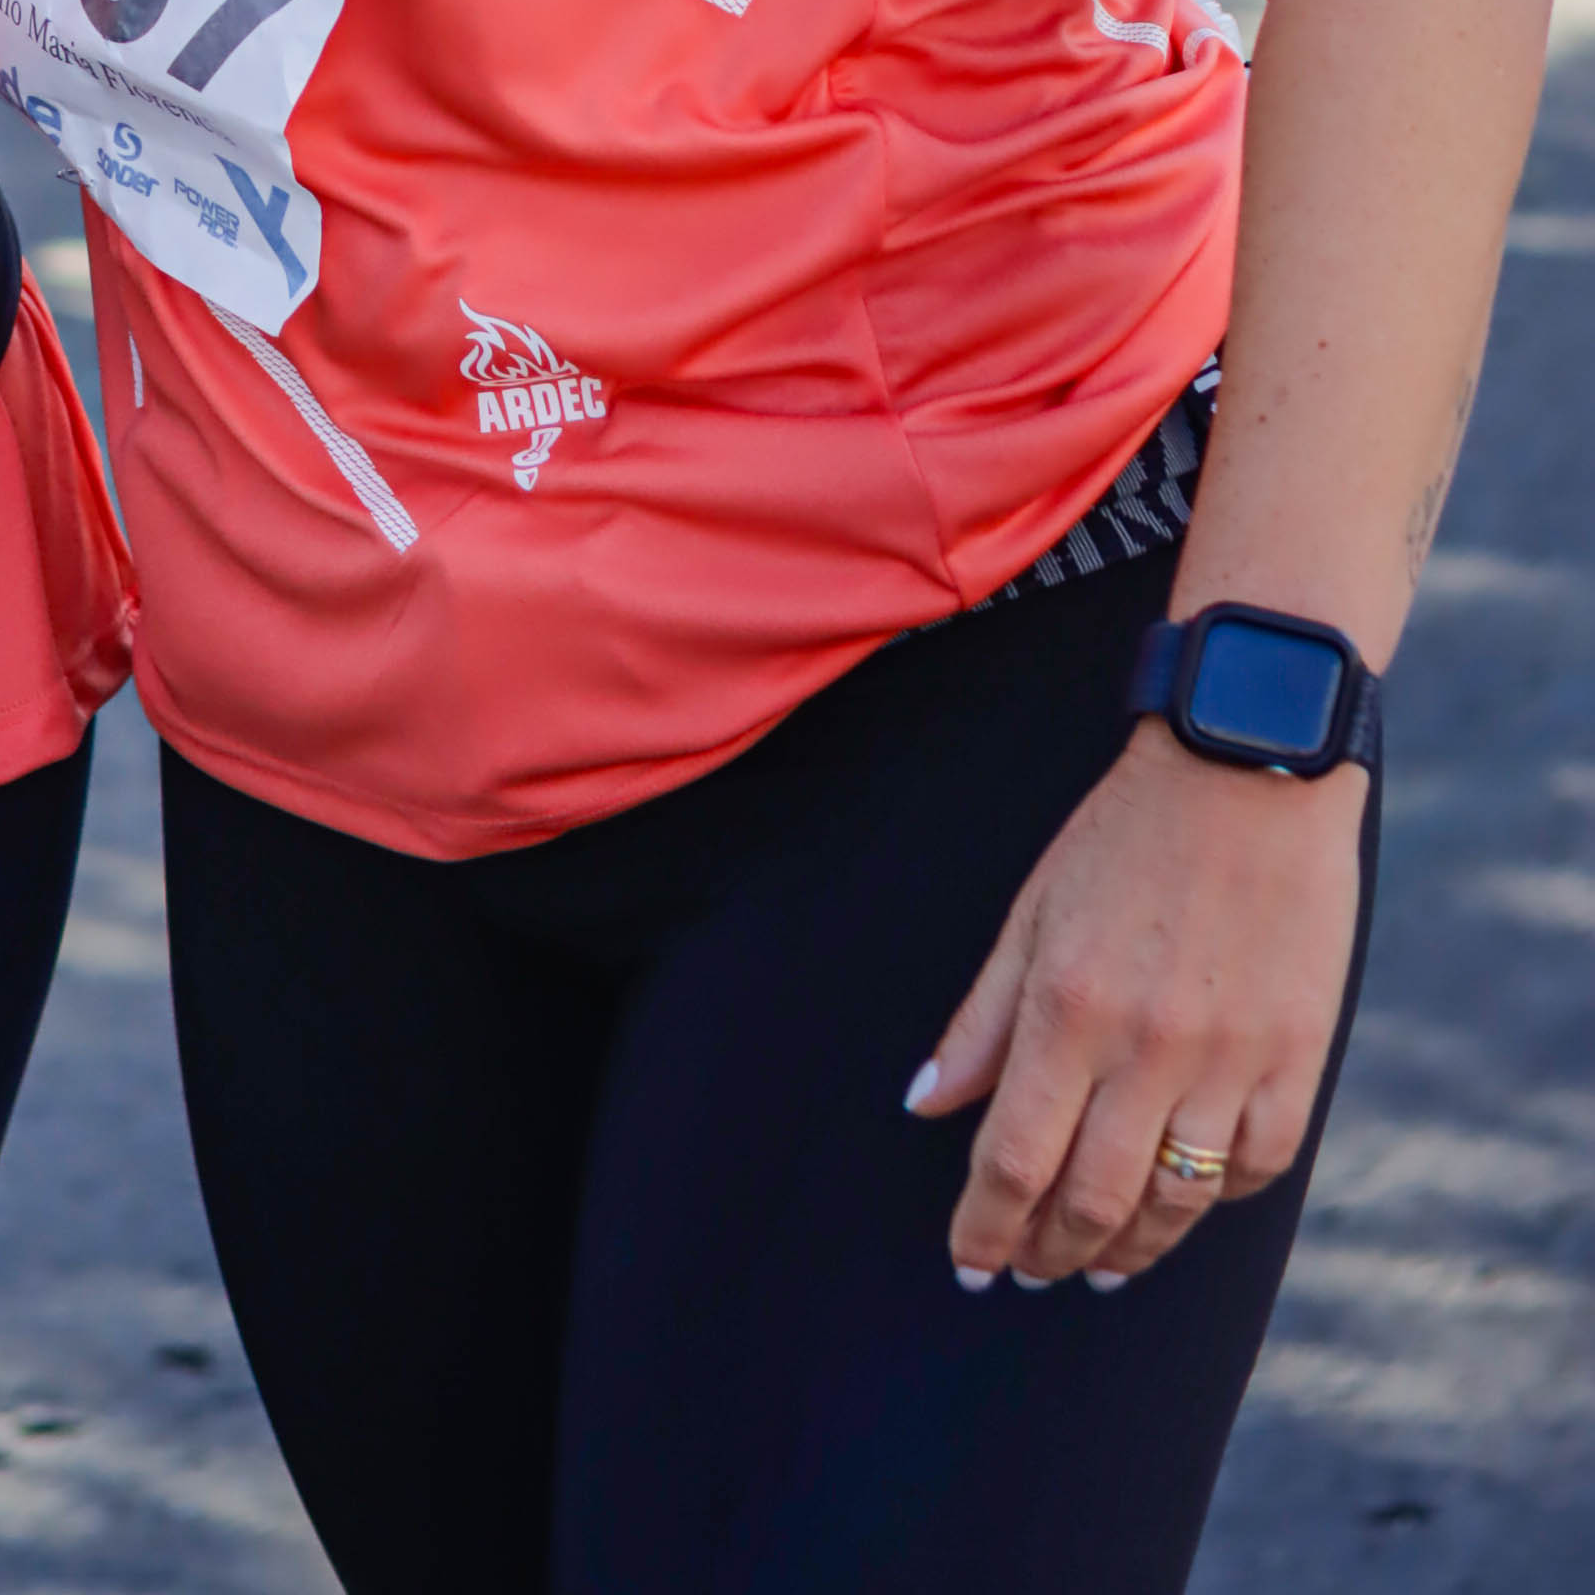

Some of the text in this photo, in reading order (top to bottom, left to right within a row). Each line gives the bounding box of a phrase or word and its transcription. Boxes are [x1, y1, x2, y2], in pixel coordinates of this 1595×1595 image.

[28, 2, 100, 82] Maria
[98, 60, 237, 147] Florenc
[173, 177, 240, 228] POWER
[477, 375, 606, 434] ARDEC
